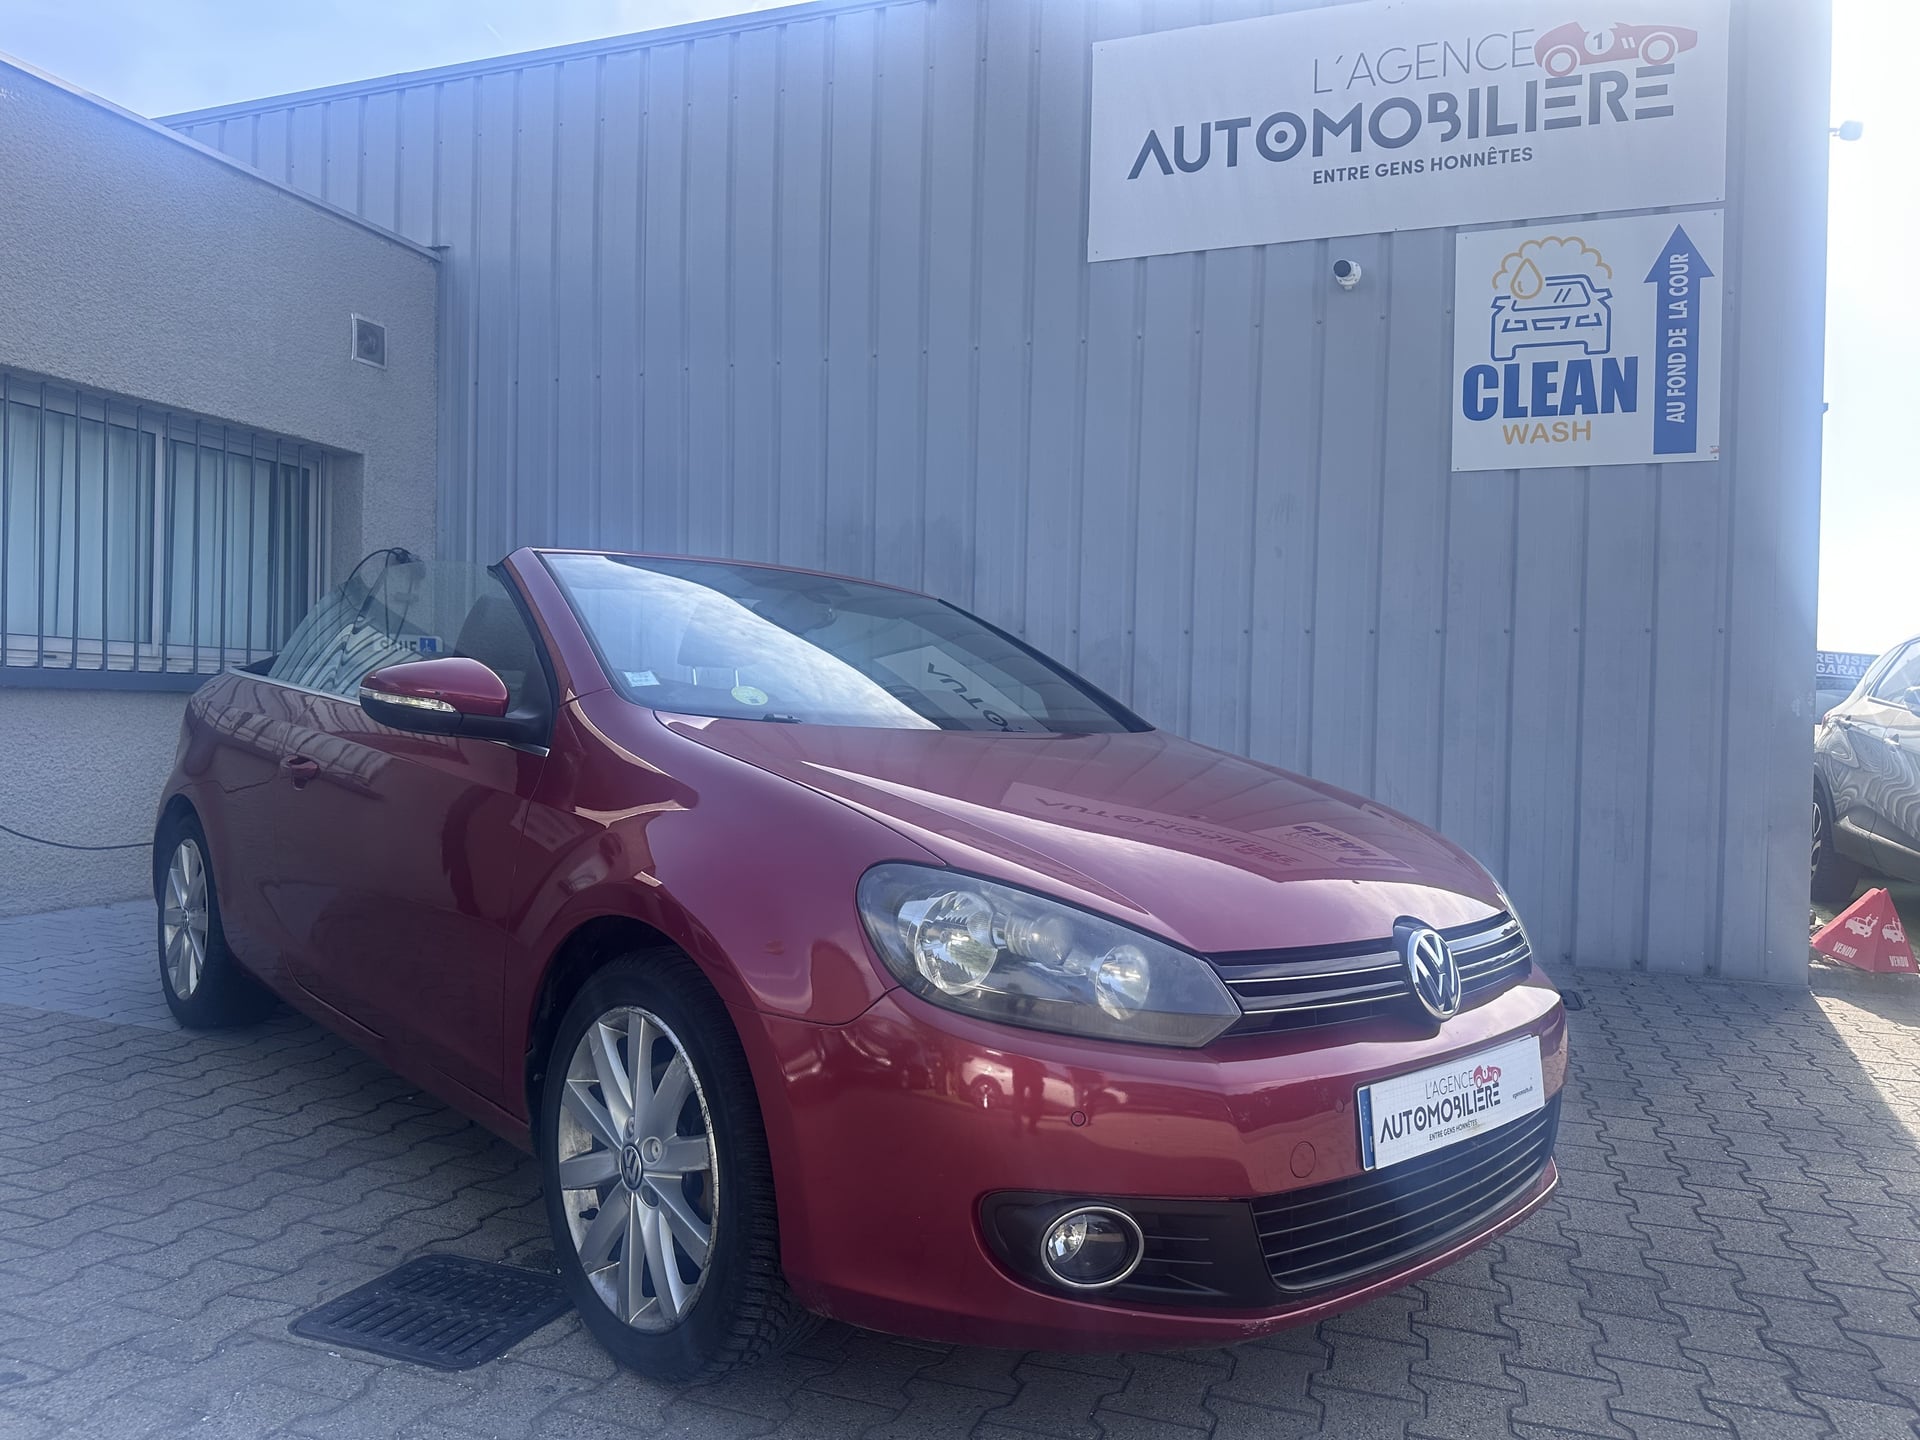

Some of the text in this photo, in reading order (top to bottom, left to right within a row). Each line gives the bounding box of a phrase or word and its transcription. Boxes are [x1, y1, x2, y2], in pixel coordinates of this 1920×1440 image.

[1592, 32, 1604, 50] 1
[1127, 63, 1676, 180] AUTOMOBILIERE
[1313, 145, 1534, 185] ENTRE GENS HONNÊTES
[1666, 252, 1689, 423] AU FOND DE LA COUR
[1462, 356, 1639, 421] CLEAN
[1502, 420, 1592, 445] WASH
[1833, 941, 1857, 958] VENDU
[1888, 956, 1909, 967] VENDU
[1380, 1083, 1501, 1143] AUTOMOBILIERE
[1428, 1130, 1443, 1141] ENTRE
[1443, 1126, 1456, 1136] GENS
